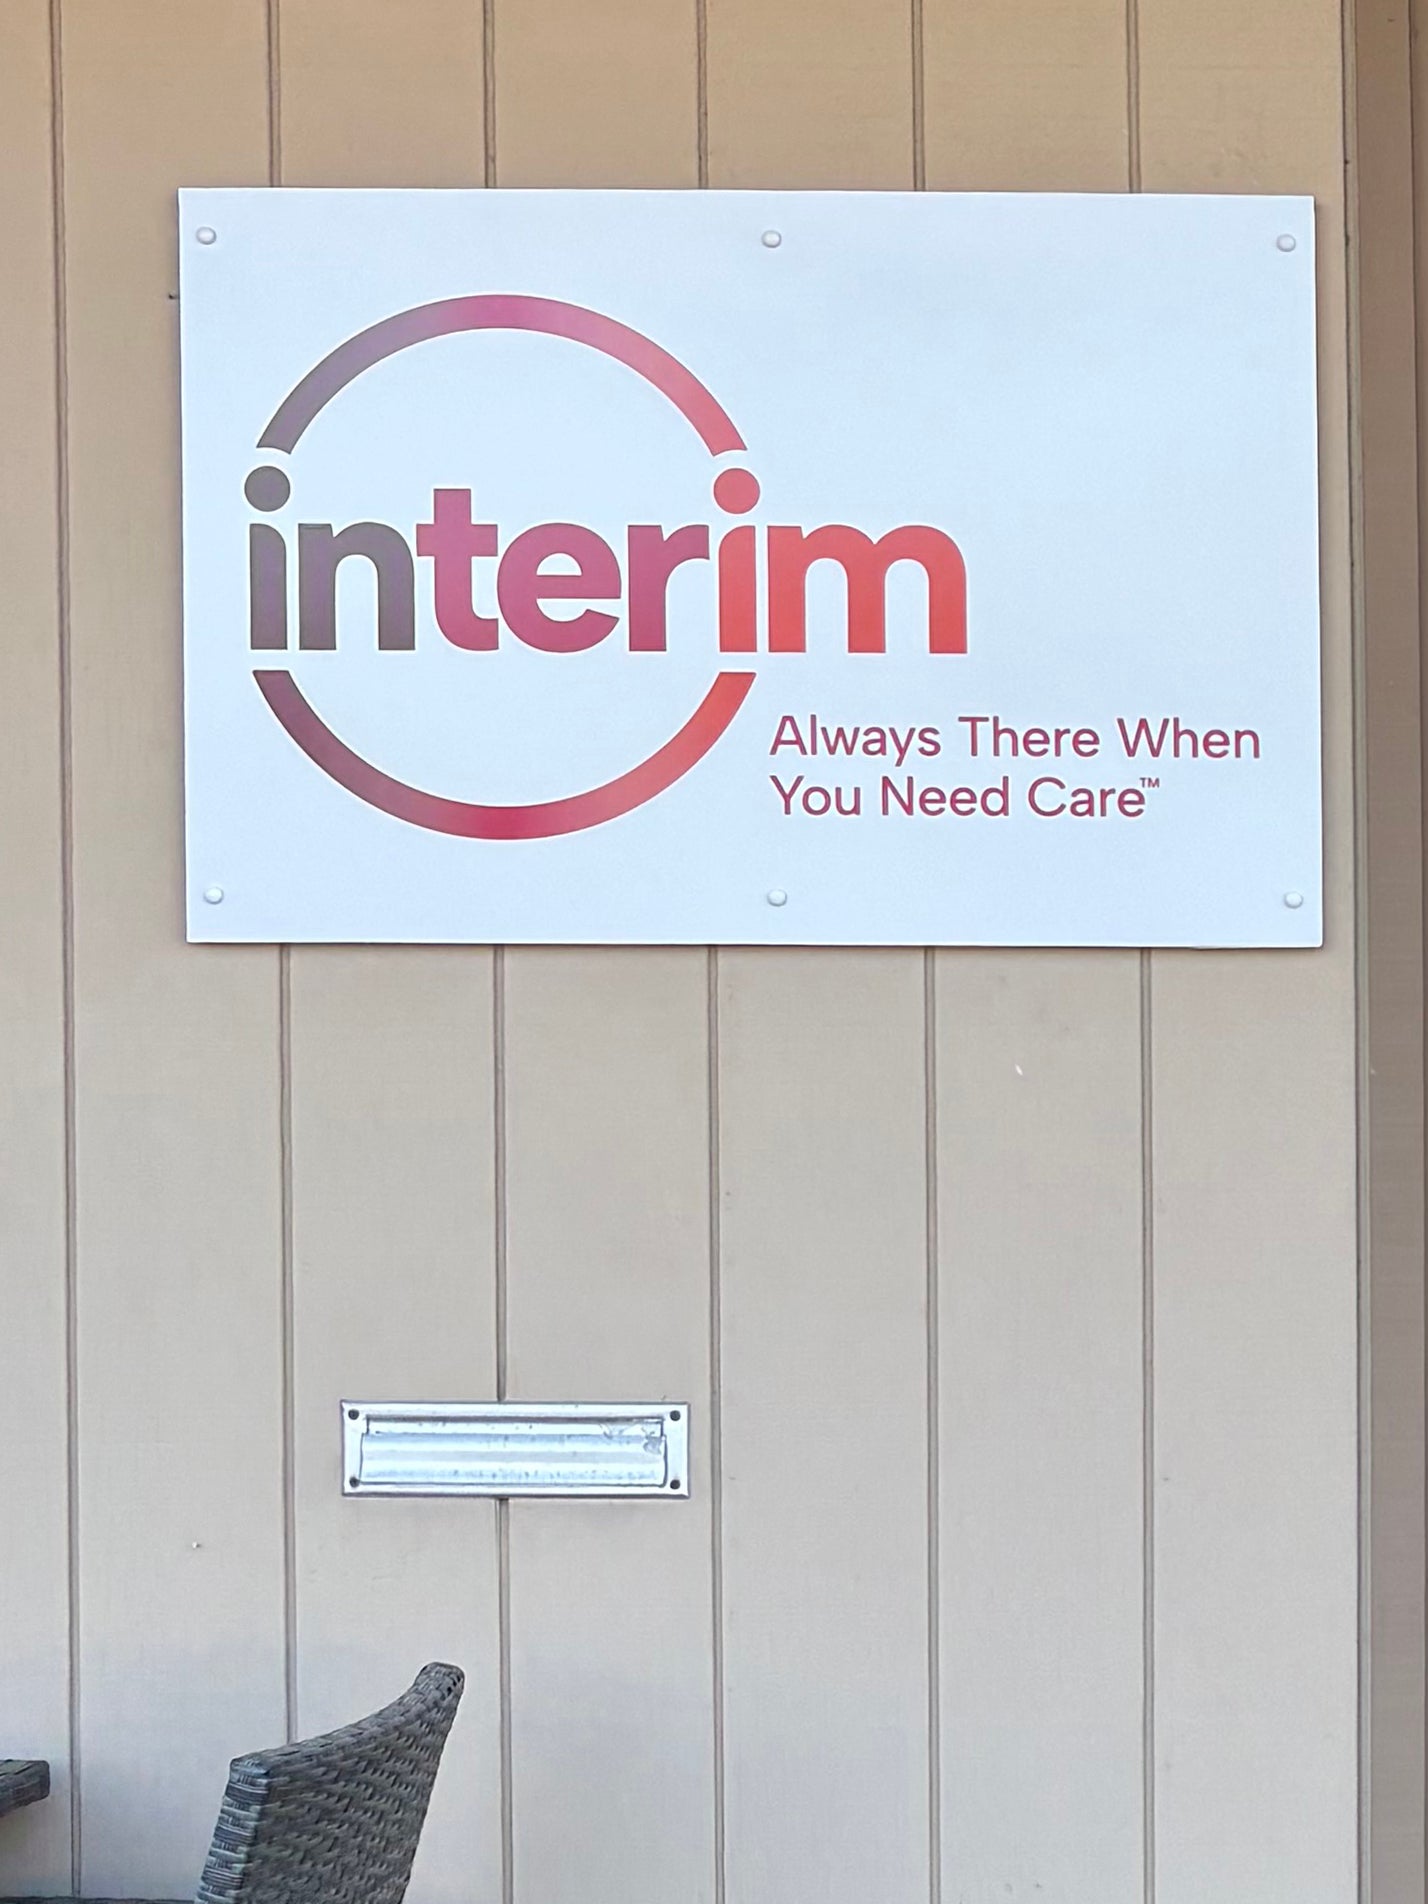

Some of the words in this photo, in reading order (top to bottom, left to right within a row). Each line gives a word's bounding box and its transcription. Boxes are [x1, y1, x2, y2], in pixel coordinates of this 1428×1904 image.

[243, 465, 968, 655] interim
[769, 714, 941, 766] Always
[958, 716, 1100, 757] There
[1116, 717, 1261, 759] When
[769, 775, 861, 816] You
[881, 775, 1009, 817] Need
